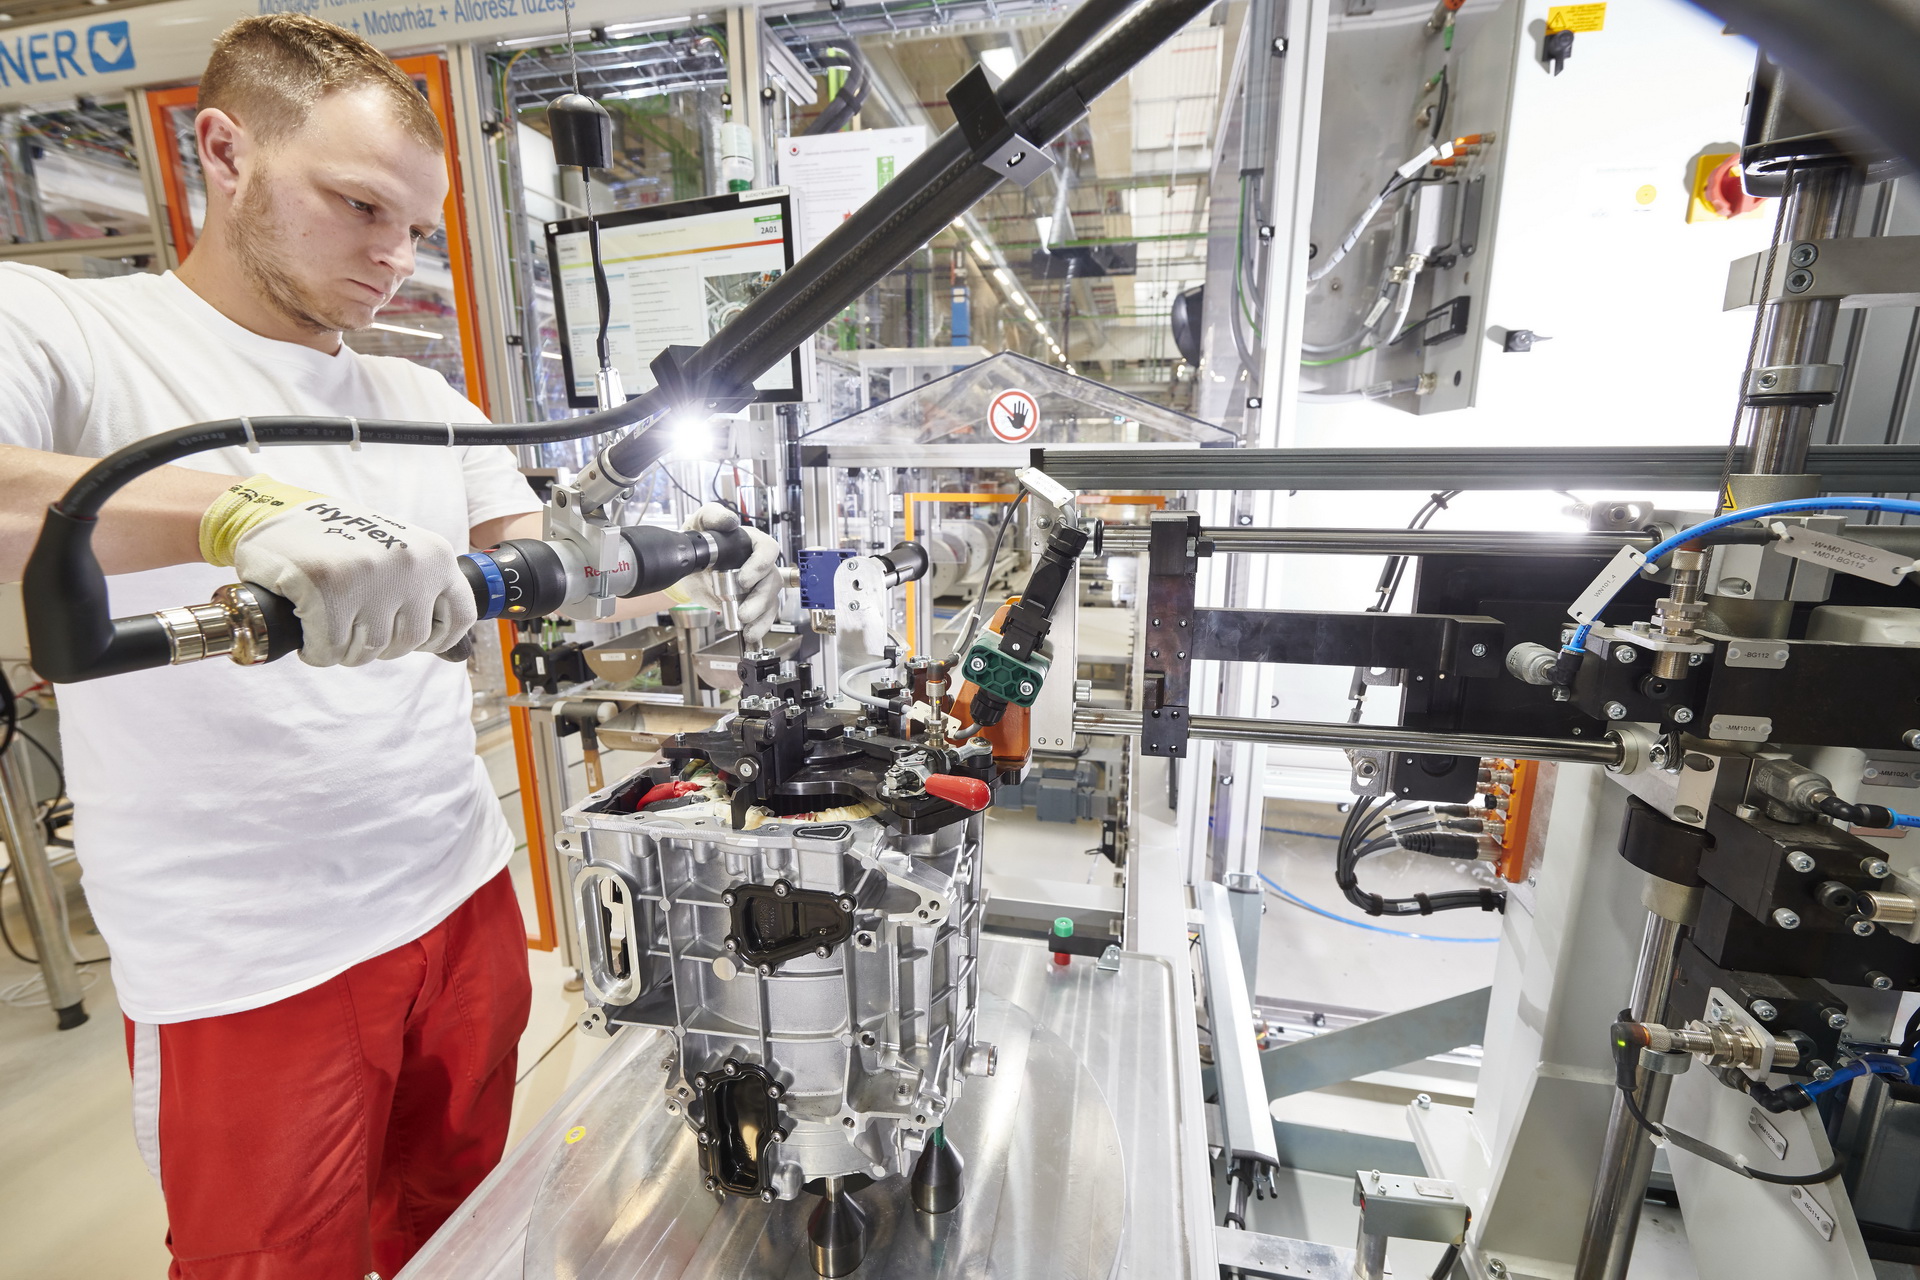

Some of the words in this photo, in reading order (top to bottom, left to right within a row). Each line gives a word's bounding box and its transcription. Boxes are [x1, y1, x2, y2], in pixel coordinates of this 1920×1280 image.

[363, 3, 437, 36] Motorház
[760, 226, 778, 235] 2A01
[1813, 550, 1866, 570] +M01-BG112
[583, 560, 630, 578] Reth
[1593, 574, 1617, 598] WN101_4
[1744, 651, 1770, 659] -BG112
[1726, 724, 1756, 732] -MM101A
[1878, 769, 1910, 778] -MM102A
